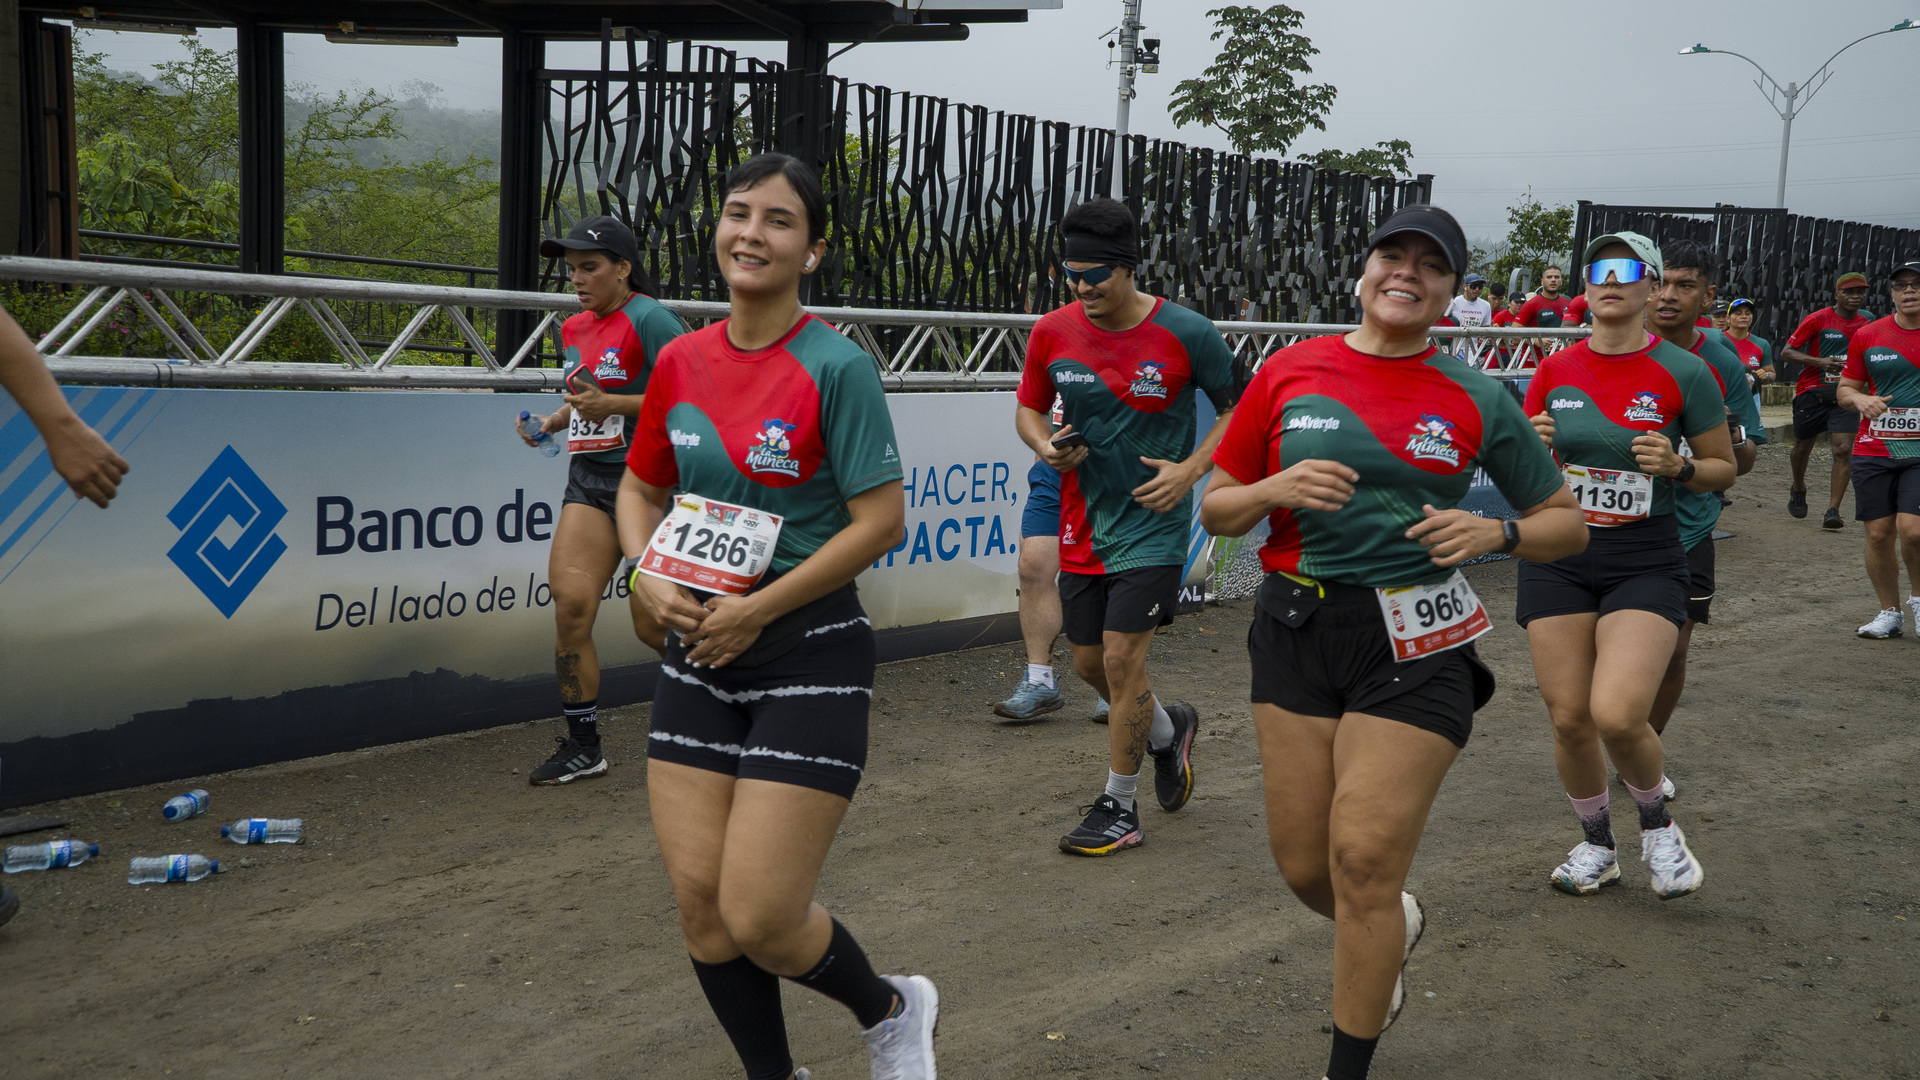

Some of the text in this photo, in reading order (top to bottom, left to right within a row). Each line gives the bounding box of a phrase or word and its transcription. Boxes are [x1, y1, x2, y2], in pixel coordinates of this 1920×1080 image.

[571, 418, 605, 437] 932
[1879, 418, 1917, 430] 1696
[760, 448, 771, 457] La
[1406, 438, 1460, 460] Muñeca
[746, 451, 800, 471] Muñeca
[1572, 485, 1634, 511] 1130
[316, 488, 553, 555] Banco de
[743, 519, 760, 530] eggy
[673, 523, 750, 567] 1266
[873, 515, 1016, 569] PACTA.
[315, 587, 378, 631] Del
[389, 581, 467, 624] lado
[476, 575, 516, 613] de
[526, 572, 553, 608] lo
[1178, 585, 1202, 604] AL
[1415, 588, 1464, 628] 966
